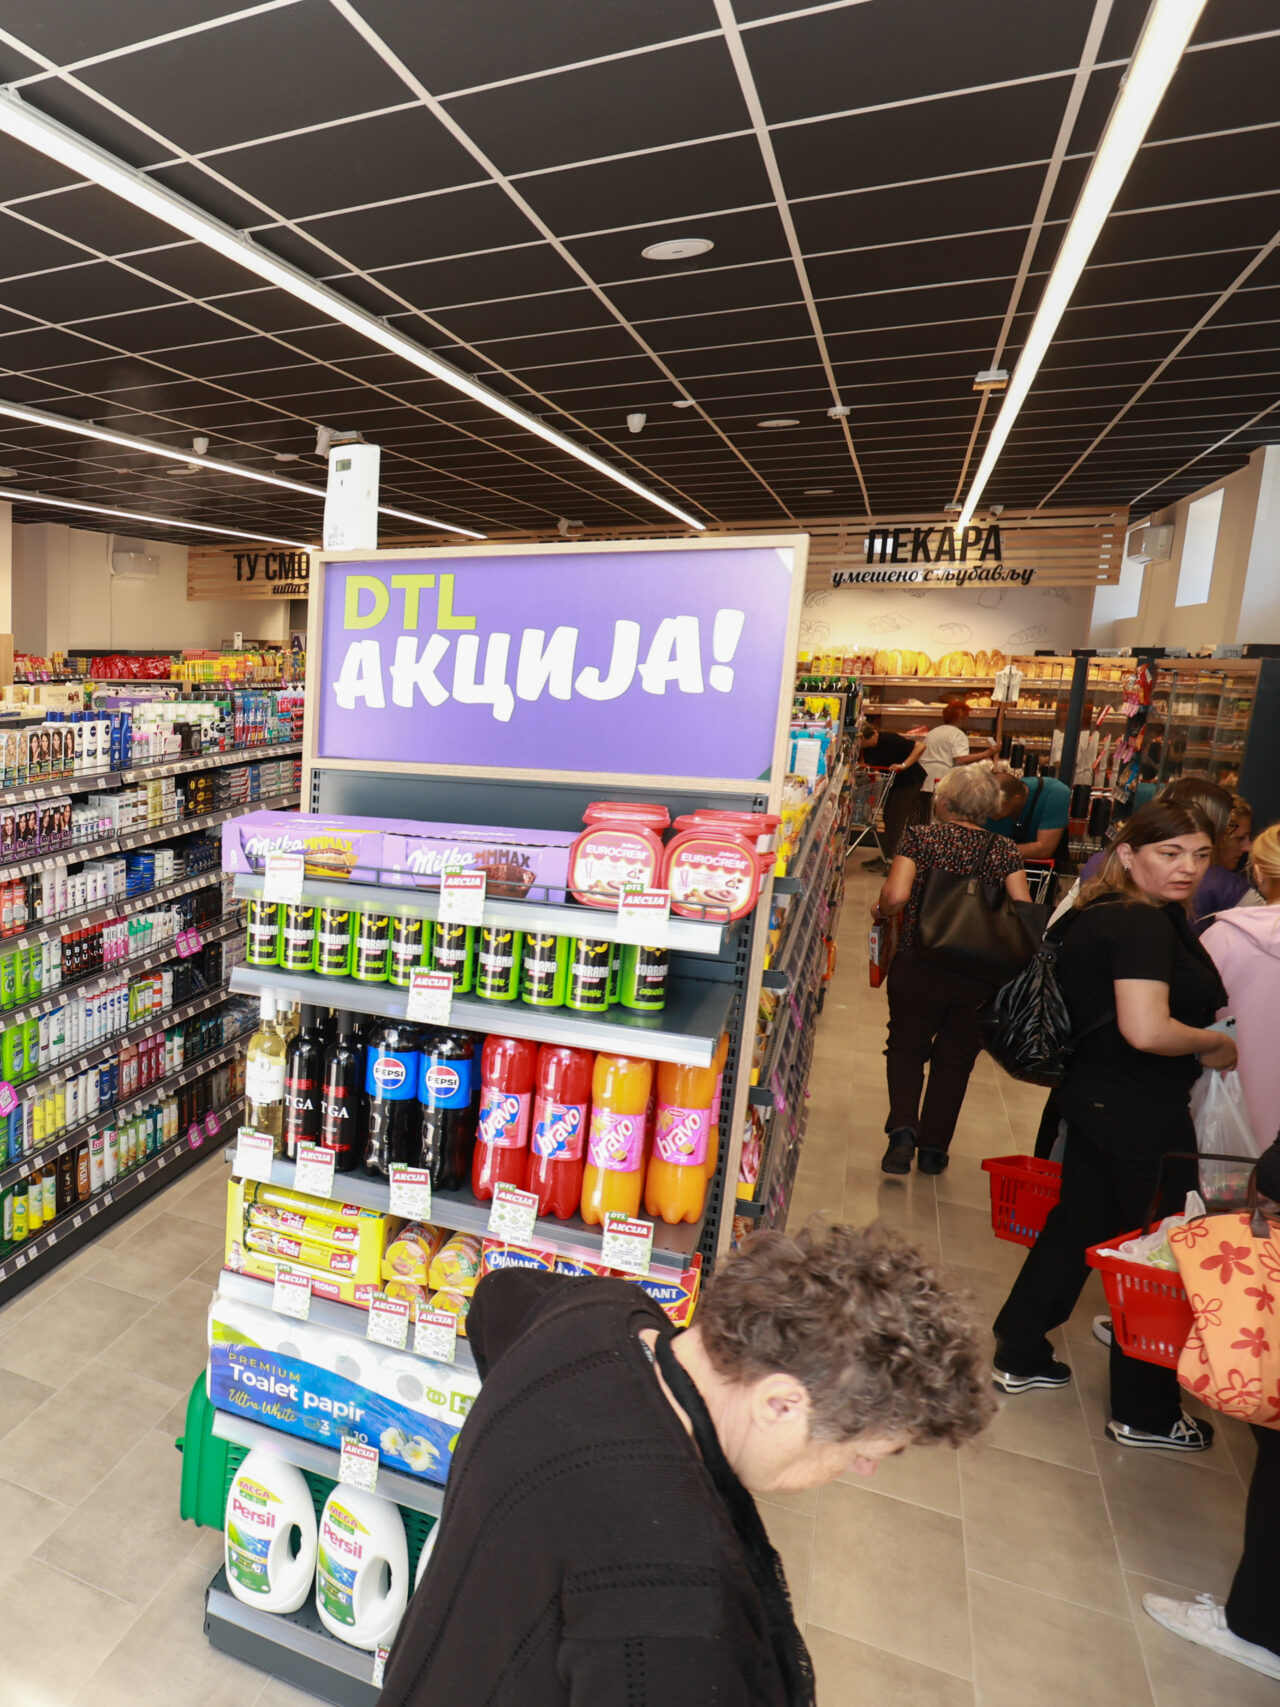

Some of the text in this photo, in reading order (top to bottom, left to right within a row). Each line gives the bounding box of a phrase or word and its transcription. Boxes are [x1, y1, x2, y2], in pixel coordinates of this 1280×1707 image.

[866, 524, 1003, 564] ПЕКАРА
[232, 553, 259, 582] ТУ
[832, 564, 1034, 587] умешено с љубављу
[343, 573, 477, 630] DTL
[332, 608, 745, 723] АКЦИЈА!
[245, 833, 305, 856] Milka
[407, 844, 531, 875] Milka MMMAX
[445, 877, 482, 887] AKCIJA
[624, 883, 643, 891] DTL
[623, 895, 665, 906] AKCIJA
[414, 977, 450, 988] AKCIJA
[375, 1067, 404, 1079] PEPSI
[428, 1076, 458, 1086] PEPSI
[479, 1096, 519, 1143] bravo
[535, 1108, 580, 1155] bravo
[656, 1112, 702, 1160] bravo
[590, 1118, 634, 1166] bravo
[302, 1151, 332, 1162] AKCIJA
[393, 1172, 426, 1183] AKCIJA
[497, 1192, 533, 1206] AKCIJA
[610, 1212, 626, 1220] DTL
[333, 1231, 355, 1240] FINO
[609, 1221, 649, 1236] AKCIJA
[331, 1260, 351, 1269] FINO
[279, 1272, 308, 1285] AKCIJA
[373, 1300, 405, 1313] AKCIJA
[420, 1313, 453, 1325] AKCIJA
[228, 1352, 301, 1383] PREMIUM
[229, 1363, 366, 1422] Toalet papir
[228, 1388, 298, 1422] Ultra White
[320, 1419, 330, 1431] 3
[345, 1445, 375, 1459] AKCIJA
[239, 1480, 271, 1499] MEGA
[232, 1497, 276, 1528] Persil
[329, 1505, 358, 1528] MEGA
[323, 1520, 363, 1559] Persil
